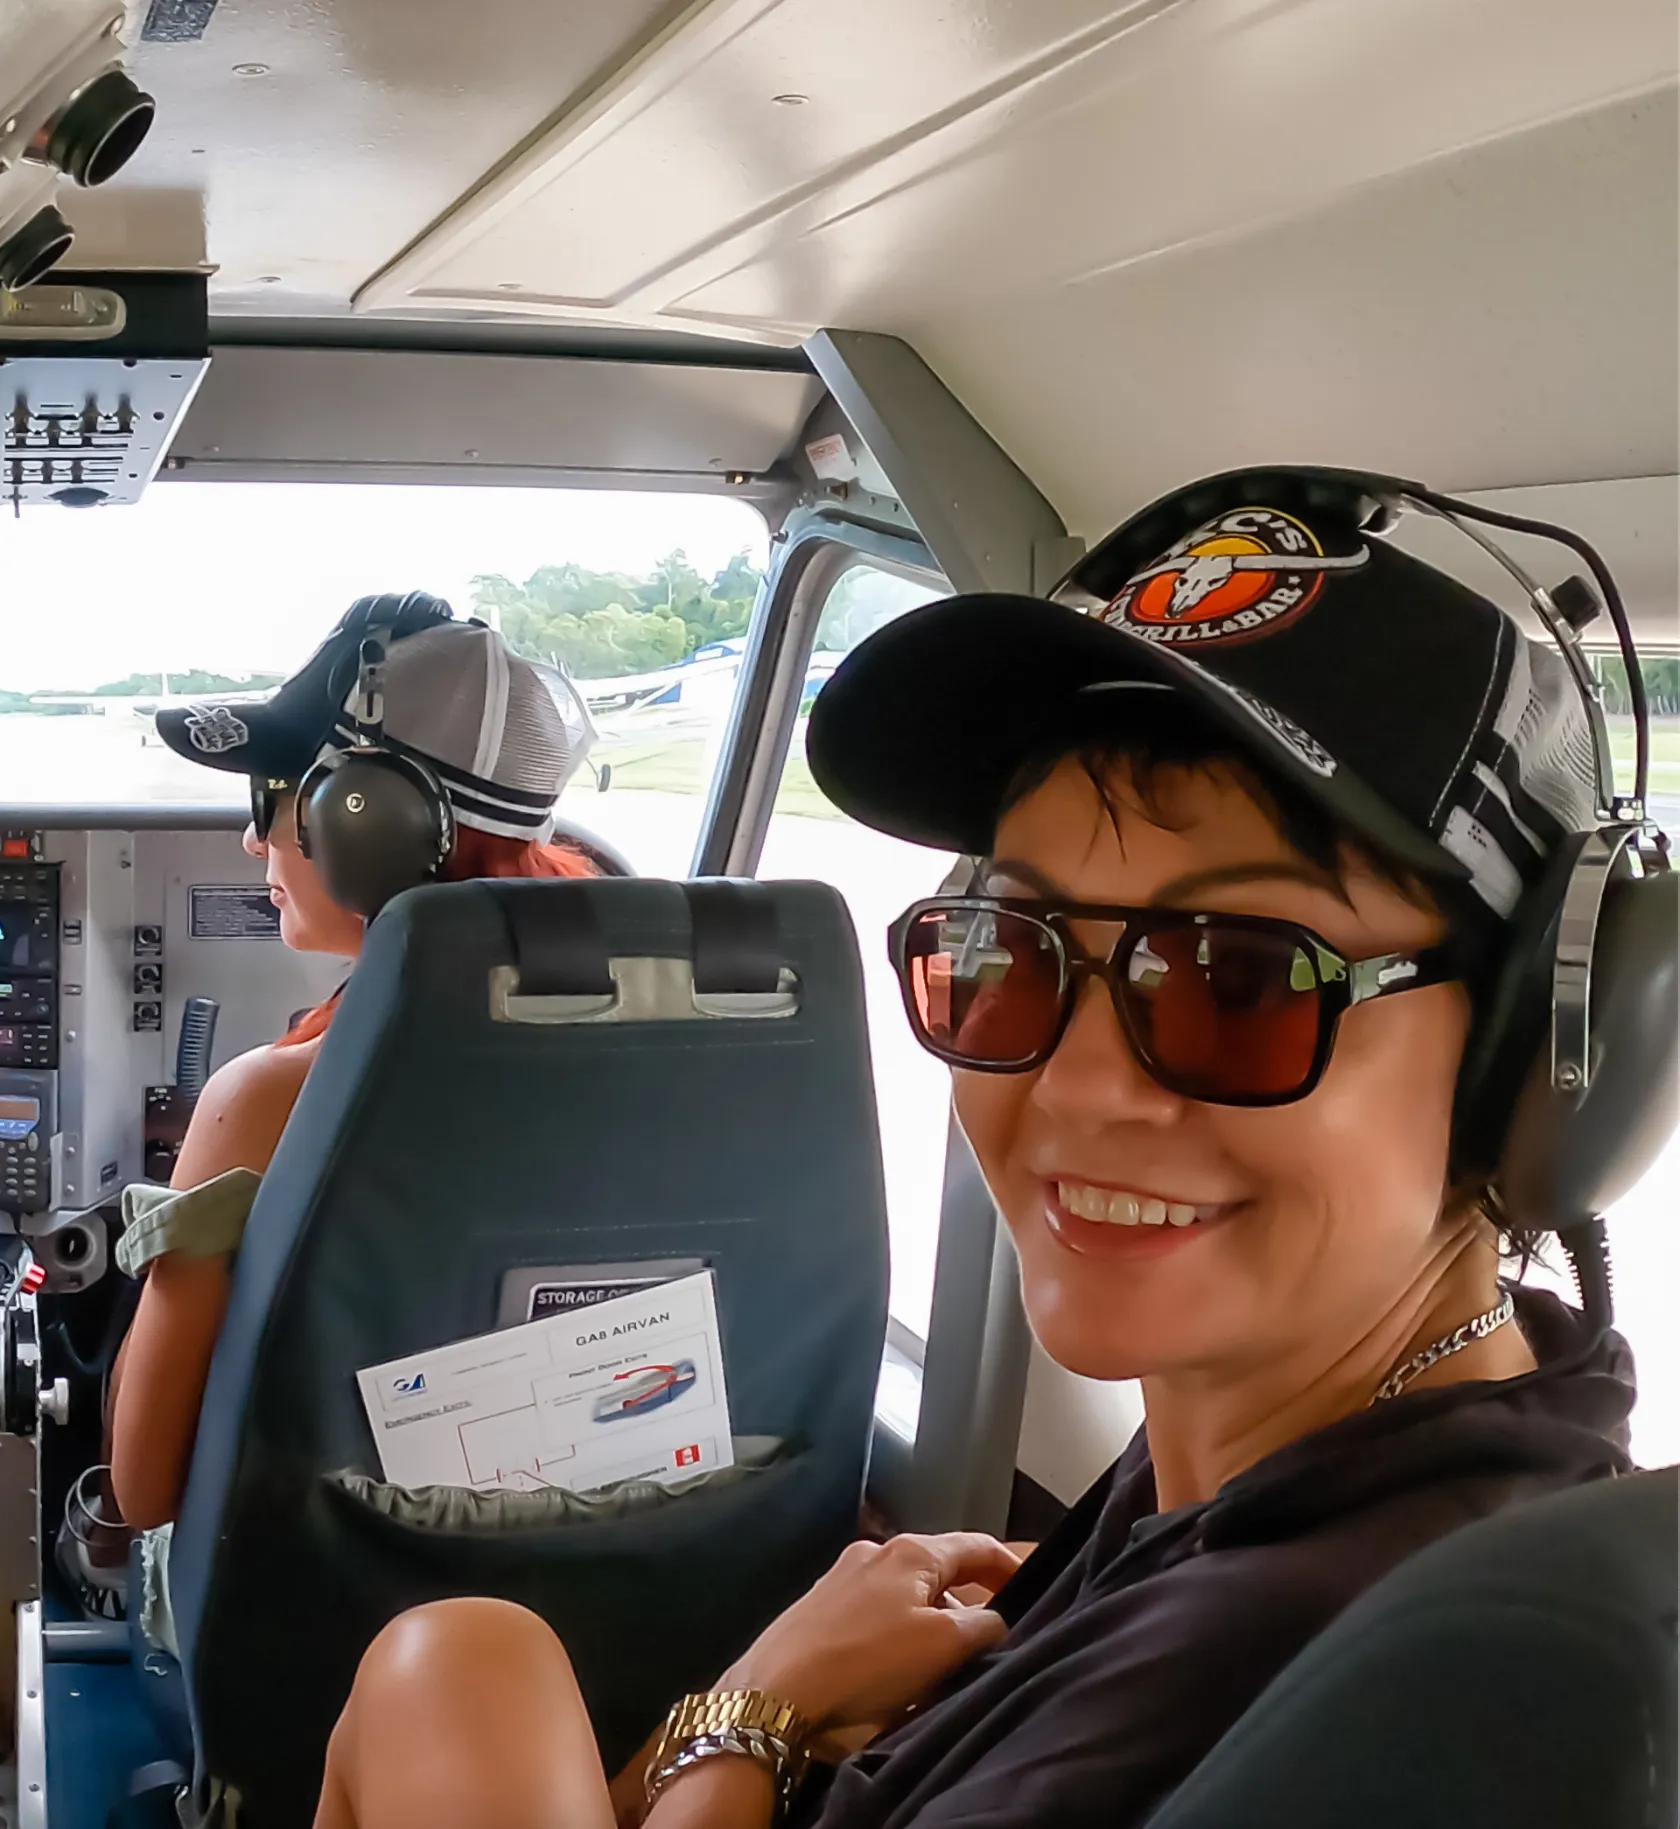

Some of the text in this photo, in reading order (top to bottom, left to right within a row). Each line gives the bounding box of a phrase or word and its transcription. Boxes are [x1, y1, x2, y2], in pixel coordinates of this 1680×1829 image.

[1233, 587, 1304, 630] BAR
[537, 1289, 604, 1304] STORAGE
[576, 1312, 670, 1347] GA8 AIRVAN
